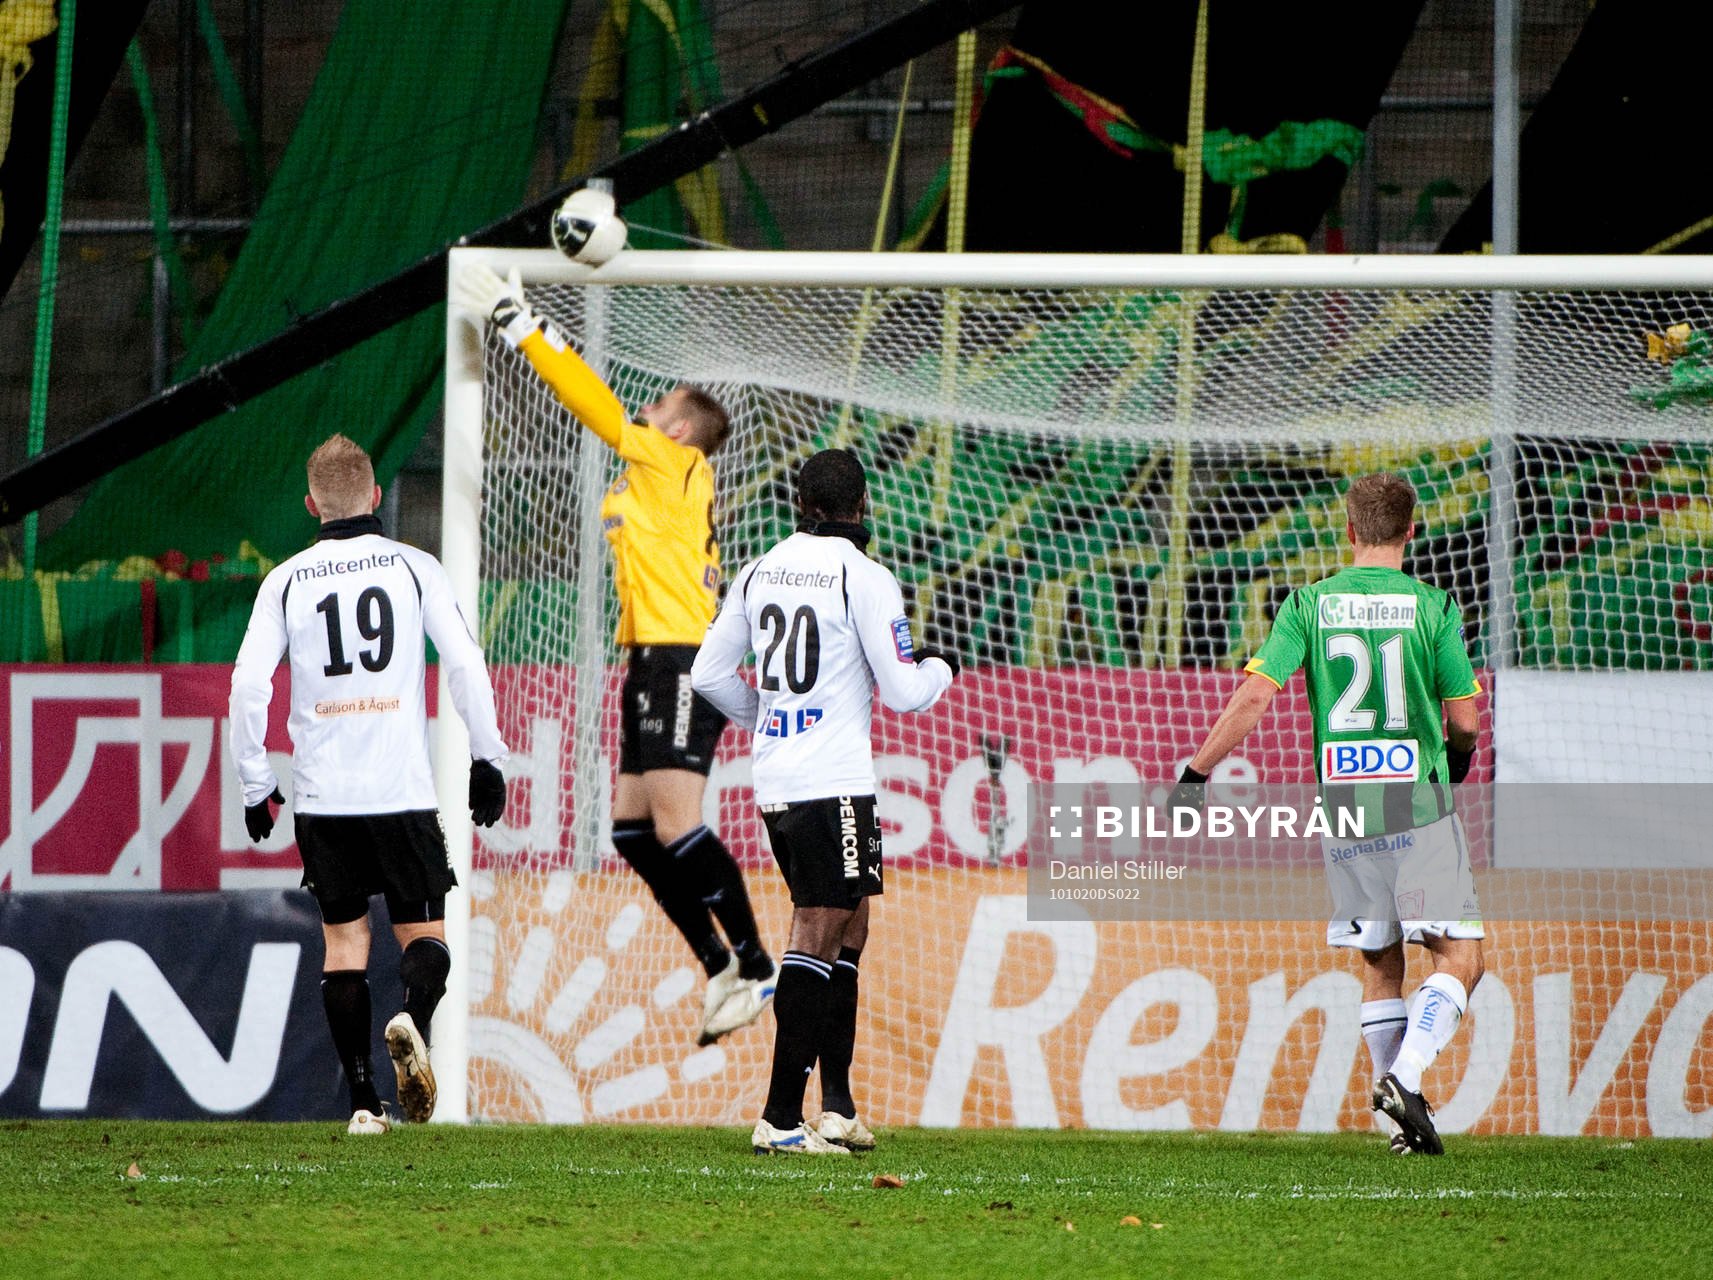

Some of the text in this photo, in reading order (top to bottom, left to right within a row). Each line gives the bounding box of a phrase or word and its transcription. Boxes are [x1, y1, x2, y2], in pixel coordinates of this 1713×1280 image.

[296, 553, 400, 582] mätcenter
[757, 567, 838, 589] mätcenter
[316, 586, 394, 677] 19
[760, 603, 820, 694] 20
[315, 700, 356, 714] Carlson
[359, 700, 366, 711] &
[674, 673, 693, 748] DEMCOM
[1325, 633, 1408, 731] 21
[1335, 743, 1415, 774] BDO
[839, 795, 860, 878] DEMCOM
